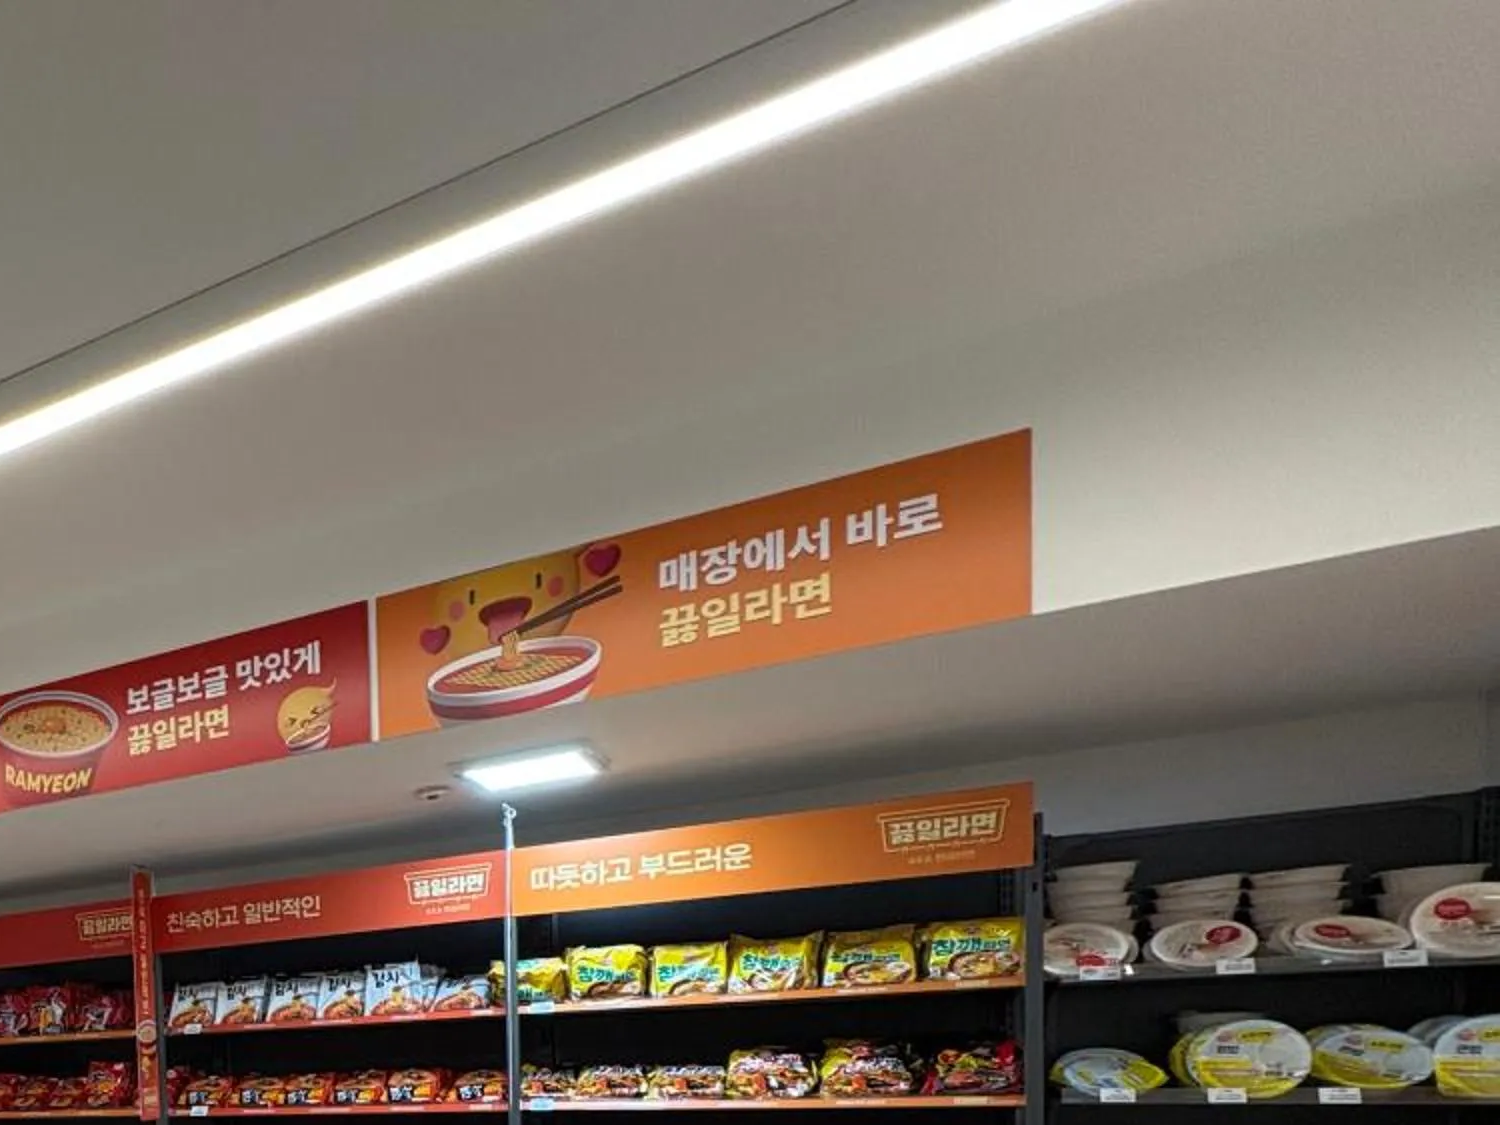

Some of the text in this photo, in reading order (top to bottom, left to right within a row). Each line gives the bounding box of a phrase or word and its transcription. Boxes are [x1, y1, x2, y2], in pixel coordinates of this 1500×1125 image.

[658, 493, 943, 591] 매장에서 바로
[659, 571, 832, 648] 끓일라면
[126, 640, 322, 715] 보글보글 맛있게
[127, 704, 230, 758] 끓일라면
[5, 763, 93, 794] RAMYEON
[638, 843, 753, 880] 부드러운
[166, 894, 321, 934] 친숙하고 일반적인
